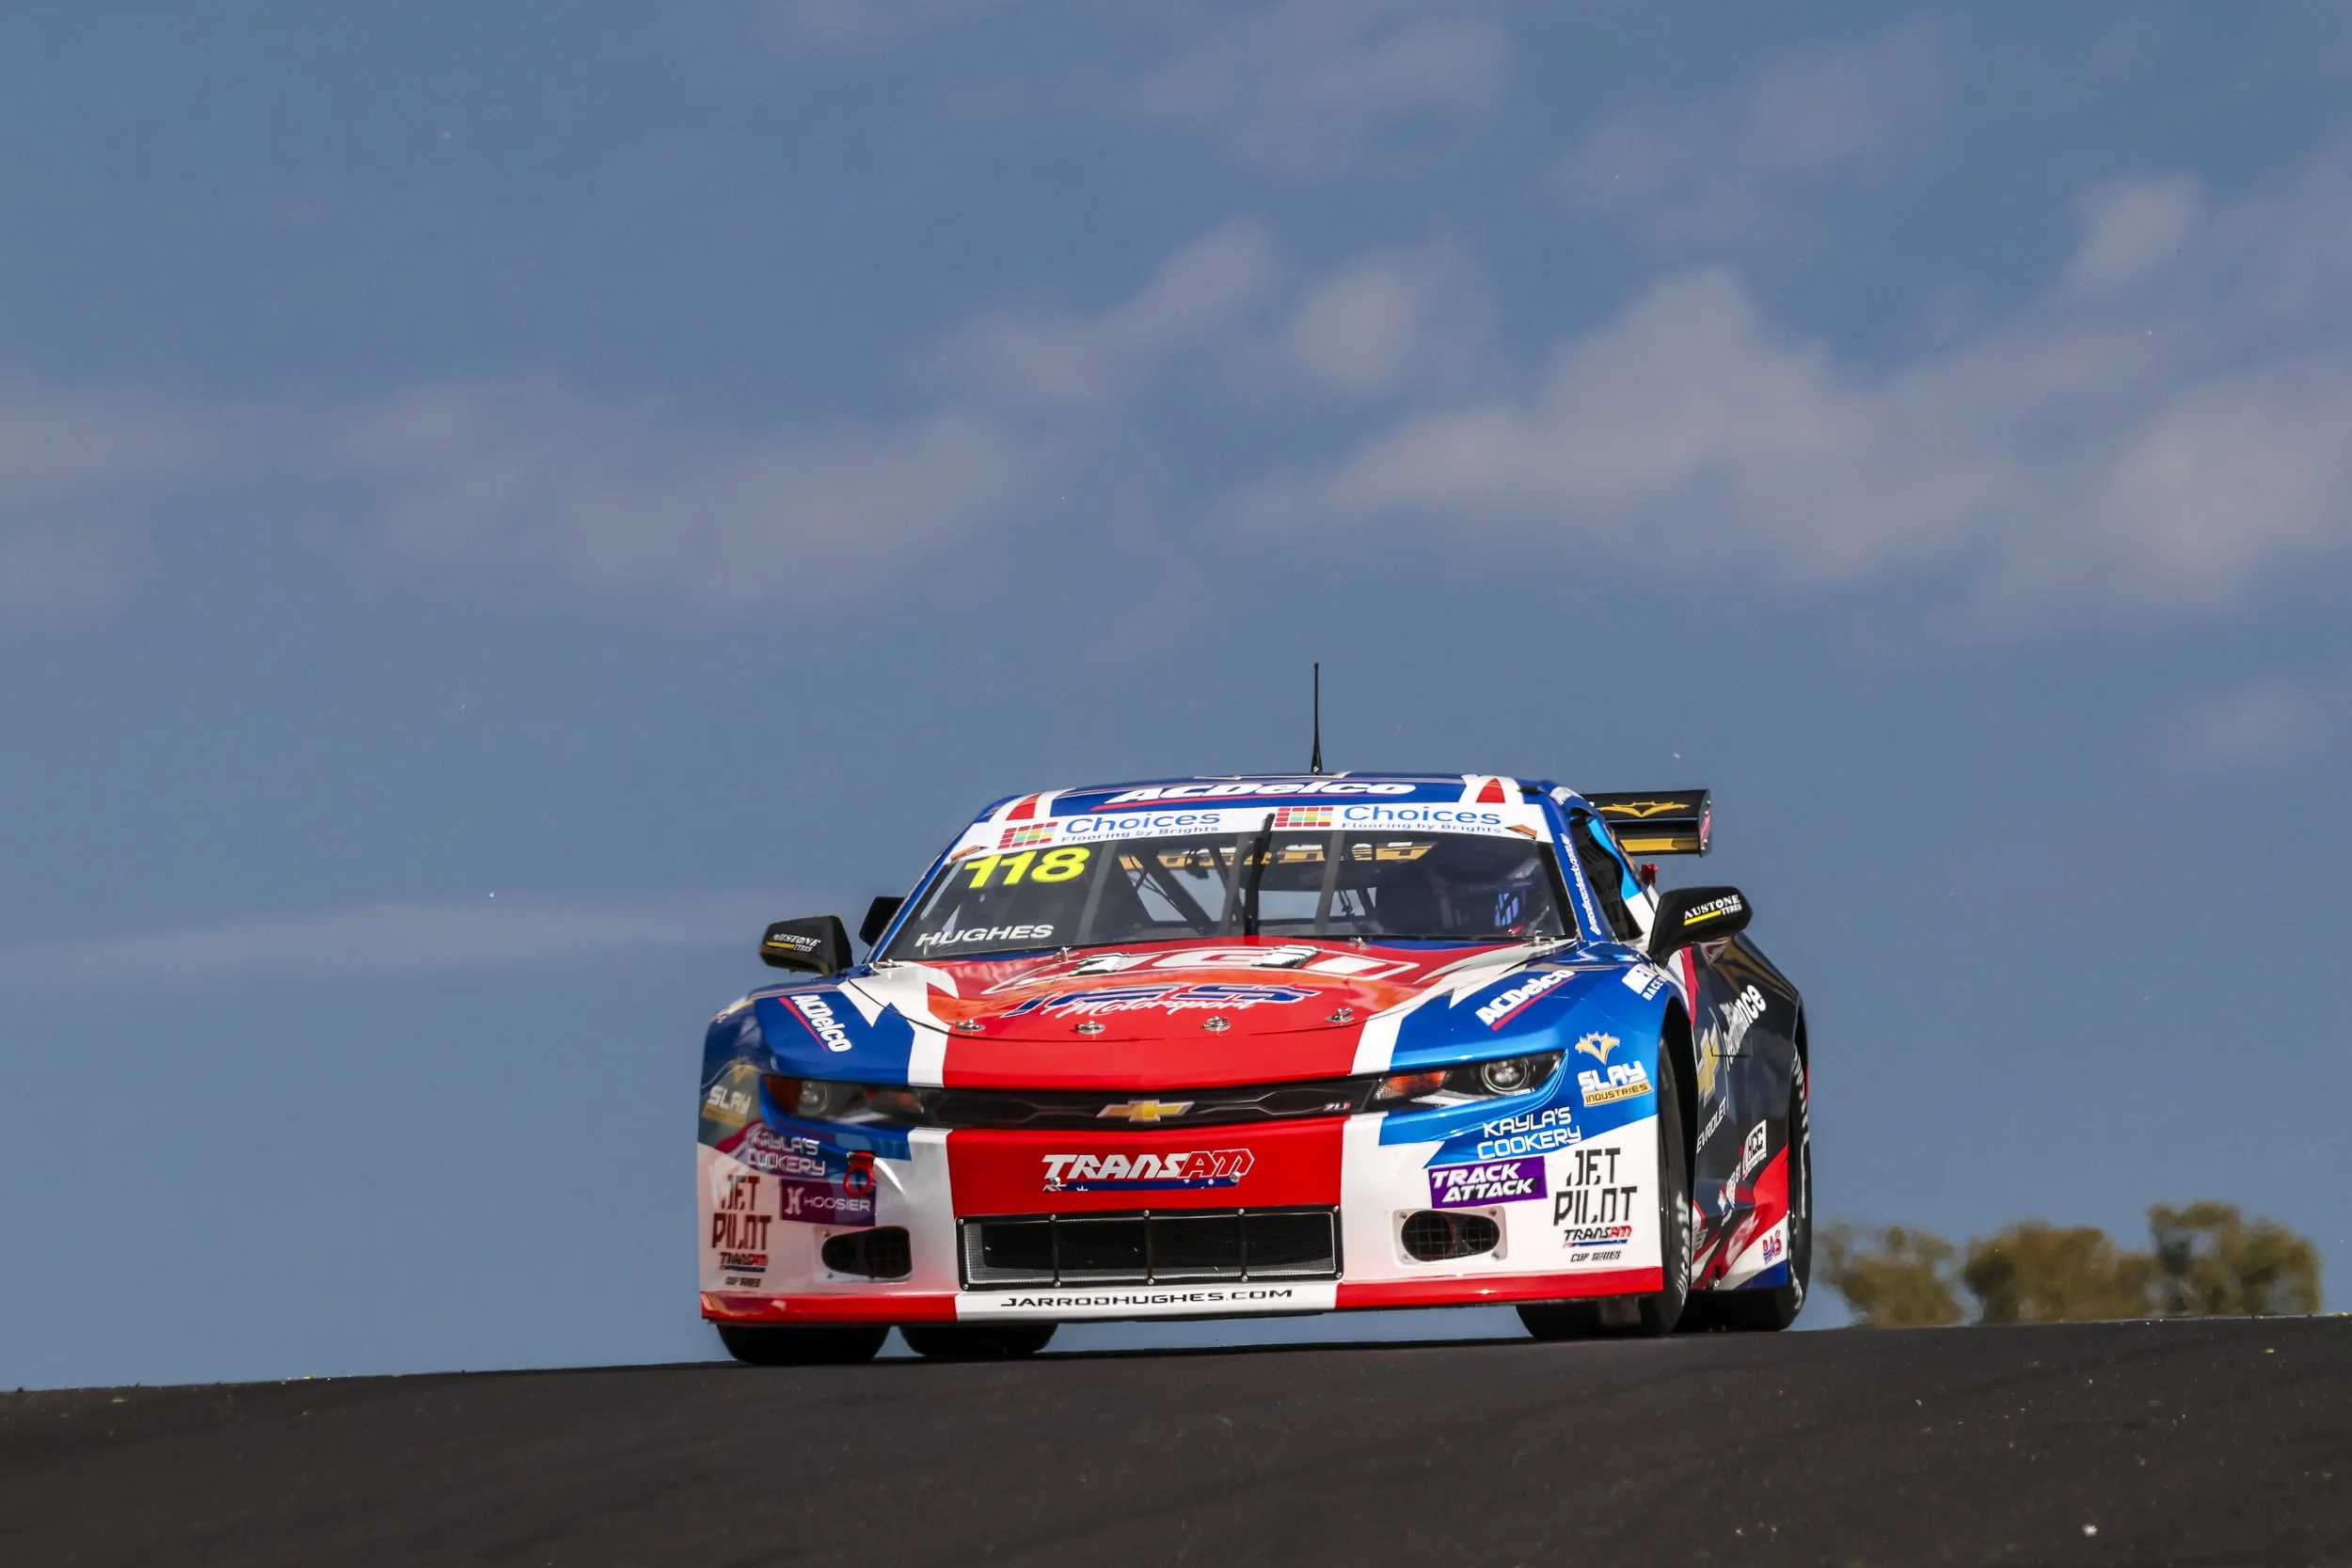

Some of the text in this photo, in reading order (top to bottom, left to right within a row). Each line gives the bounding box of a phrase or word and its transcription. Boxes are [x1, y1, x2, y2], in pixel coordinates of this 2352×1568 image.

[1103, 781, 1417, 804] ACDelco
[1064, 813, 1221, 834] Choices
[1342, 822, 1410, 831] Flooring
[1441, 824, 1502, 833] Brights
[1343, 805, 1502, 825] Choices
[1061, 831, 1130, 843] Flooring
[1158, 825, 1219, 835] Brights
[964, 847, 1091, 889] 118
[1683, 894, 1741, 920] AUSTONE
[1720, 903, 1742, 916] TYRES
[914, 924, 1055, 948] HUGHES
[1041, 998, 1258, 1019] Motorsport
[1475, 969, 1576, 1026] ACDelco
[789, 994, 852, 1053] ACDelco
[1577, 1060, 1647, 1092] SLAY
[707, 1085, 753, 1116] SLAY
[1585, 1083, 1648, 1102] INDUSTRIES
[1482, 1106, 1572, 1138] KAYLA'S
[1696, 1096, 1727, 1155] EVROLET
[1477, 1125, 1582, 1160] COOKERY
[748, 1148, 826, 1176] COOKERY
[1565, 1147, 1621, 1187] JET
[1431, 1162, 1523, 1189] TRACK
[803, 1196, 872, 1212] HOOSIER
[1441, 1178, 1534, 1204] ATTACK
[1553, 1185, 1638, 1227] PILOT
[711, 1212, 772, 1251] PILOT
[1000, 1289, 1293, 1307] JARRODHUGHES.COM
